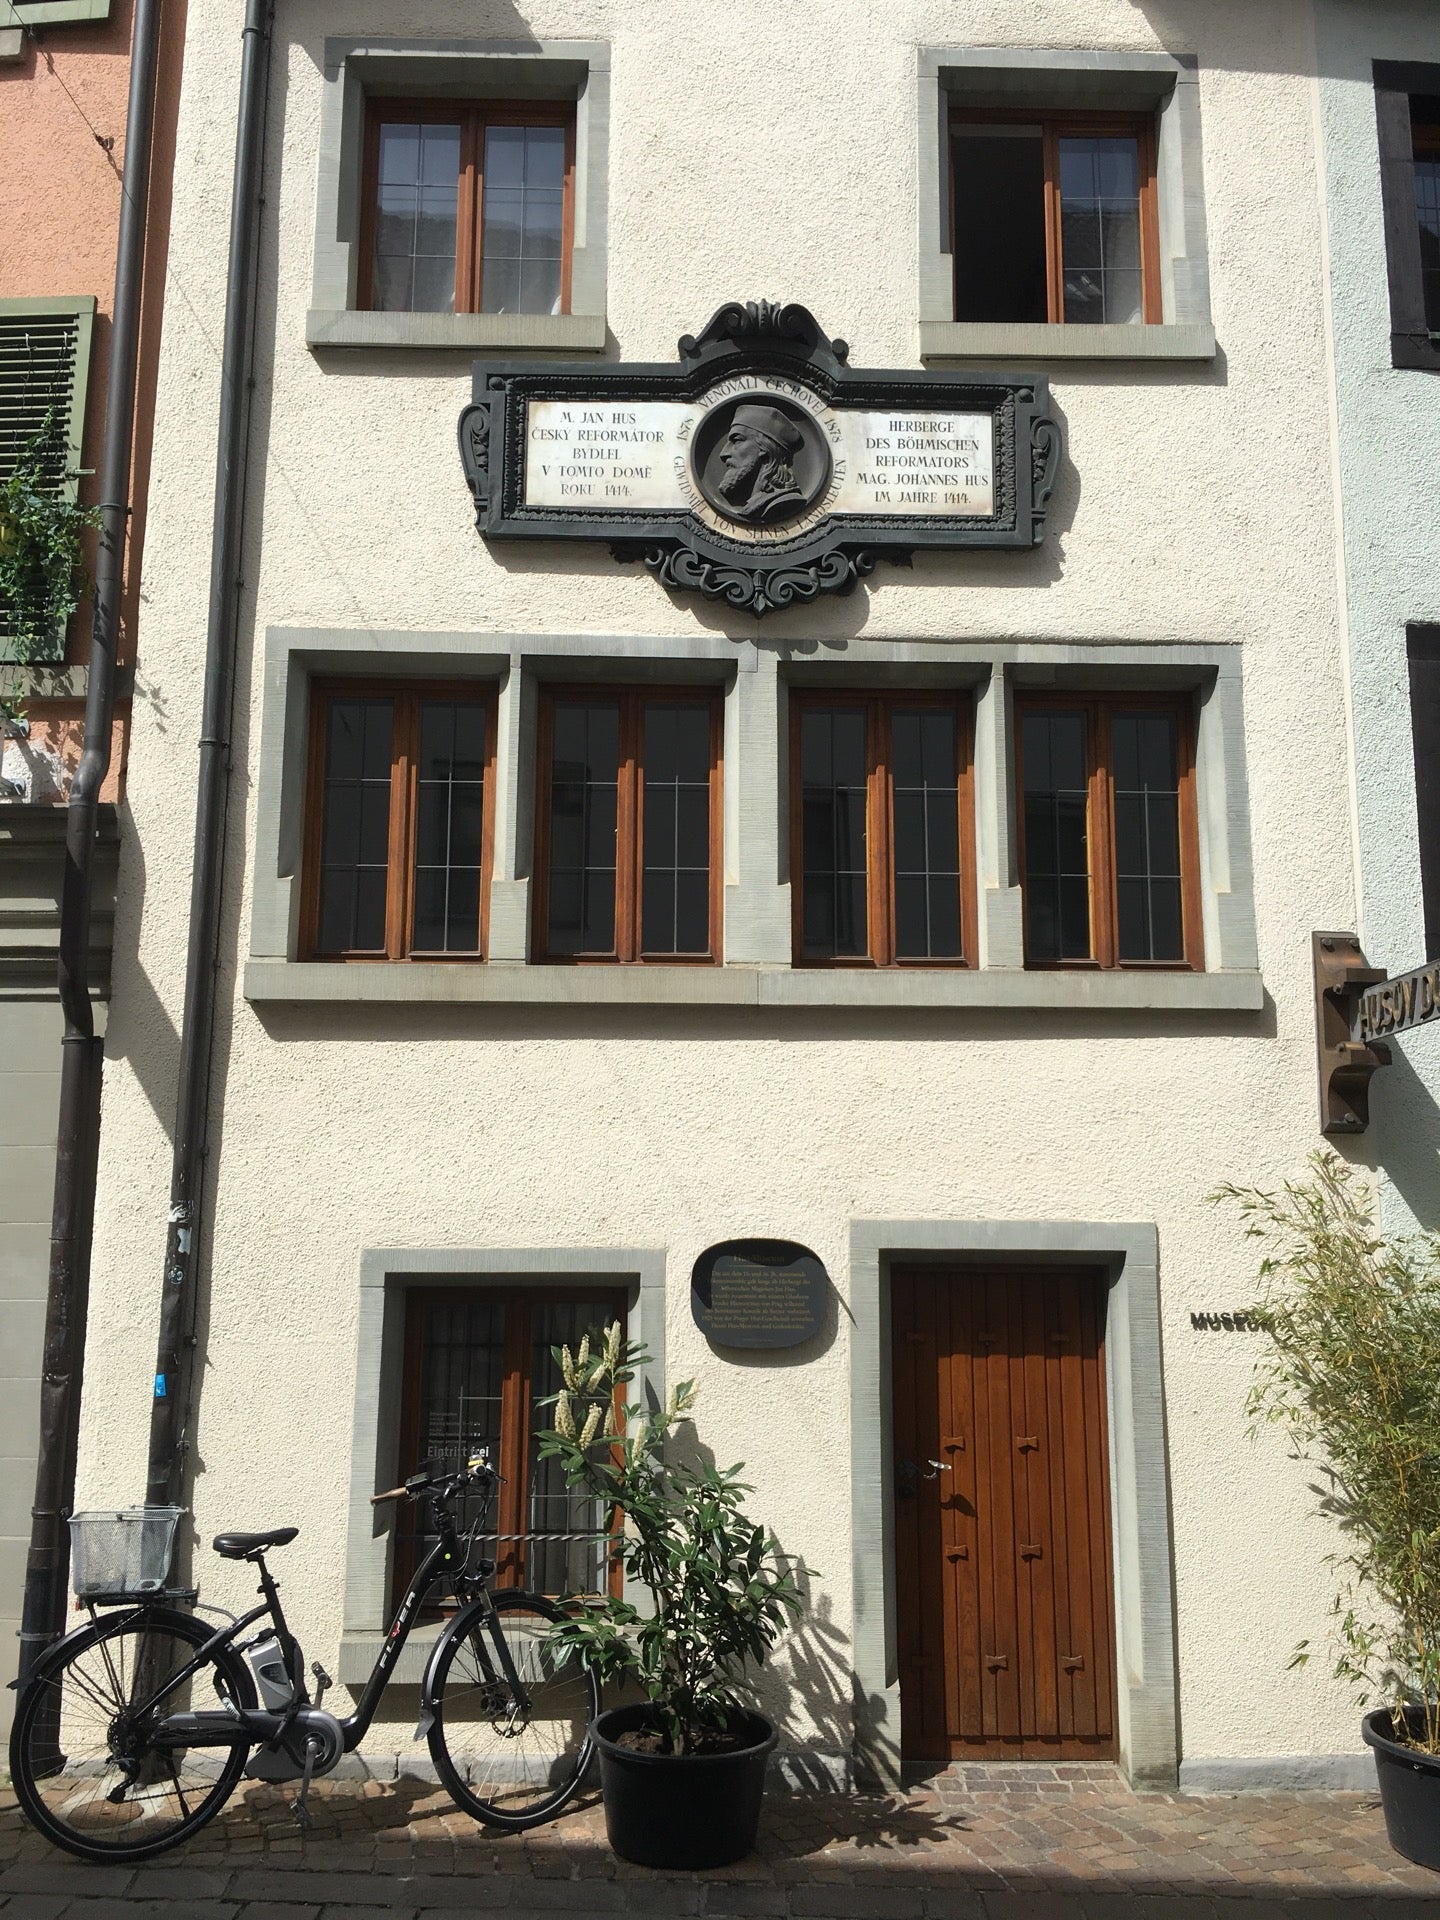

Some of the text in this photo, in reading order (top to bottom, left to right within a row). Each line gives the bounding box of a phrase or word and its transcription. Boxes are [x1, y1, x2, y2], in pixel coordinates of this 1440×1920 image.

[560, 411, 636, 424] M. JAN HUS
[676, 417, 695, 441] 1878
[824, 418, 843, 443] 1878
[889, 420, 955, 433] HERBERGE
[578, 428, 665, 443] REFORMÁTOR
[866, 435, 980, 451] DES BÖHMISCHEN
[573, 447, 622, 460] BYDLEL
[876, 455, 969, 468] REFORMATORS
[542, 465, 551, 476] V
[559, 466, 605, 478] TOMTO
[856, 473, 989, 486] MAG. JOHANNES HUS
[561, 483, 595, 496] ROKU
[673, 455, 710, 514] GEWIDMET
[713, 515, 737, 535] VON
[746, 525, 790, 538] SEINEN
[875, 490, 891, 503] IM
[897, 491, 938, 504] JAHRE
